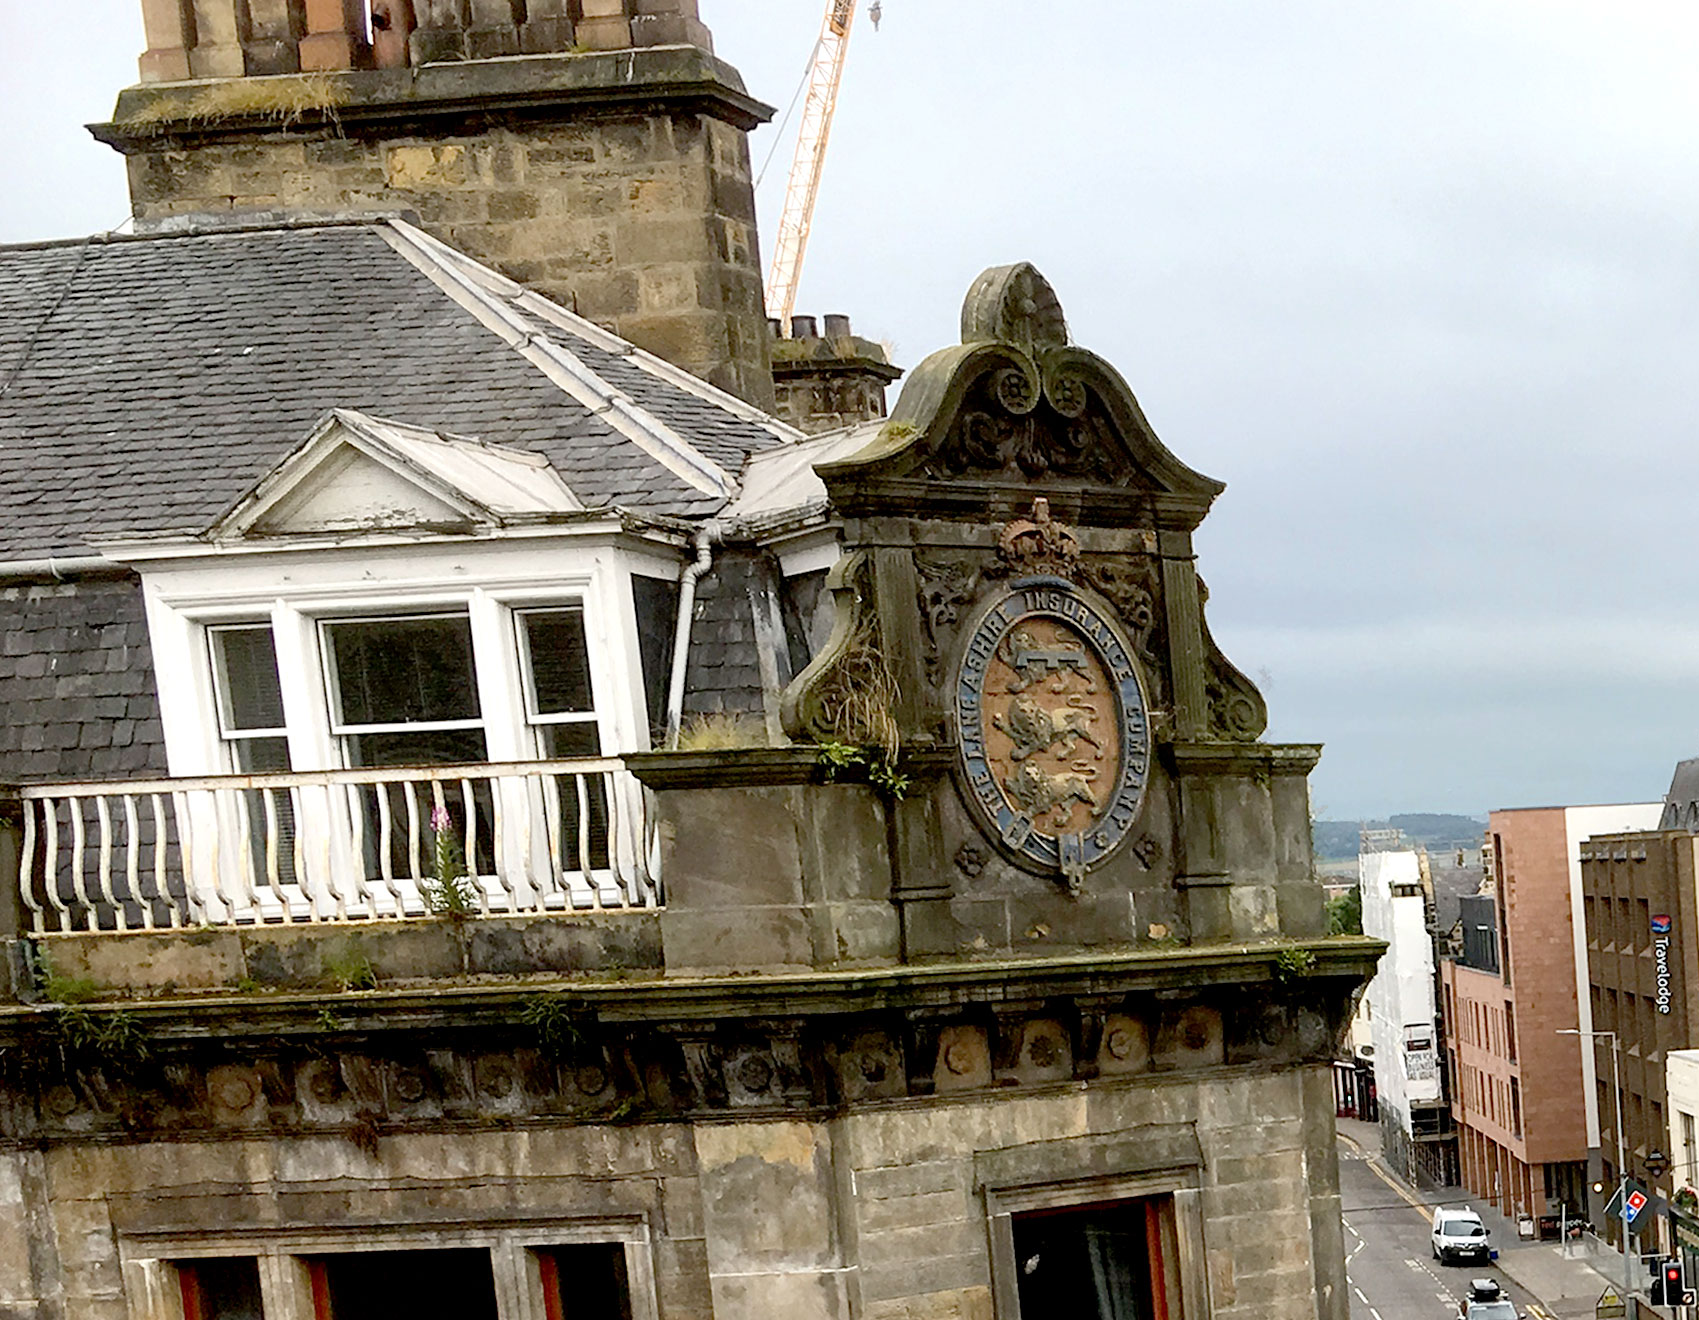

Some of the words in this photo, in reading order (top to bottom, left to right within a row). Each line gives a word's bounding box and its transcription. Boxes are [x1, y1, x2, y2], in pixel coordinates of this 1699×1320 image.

[972, 771, 1004, 817] THE
[1025, 591, 1133, 682] INSURANCE
[1110, 707, 1146, 831] COMPANY
[1655, 936, 1671, 1014] Travelodge
